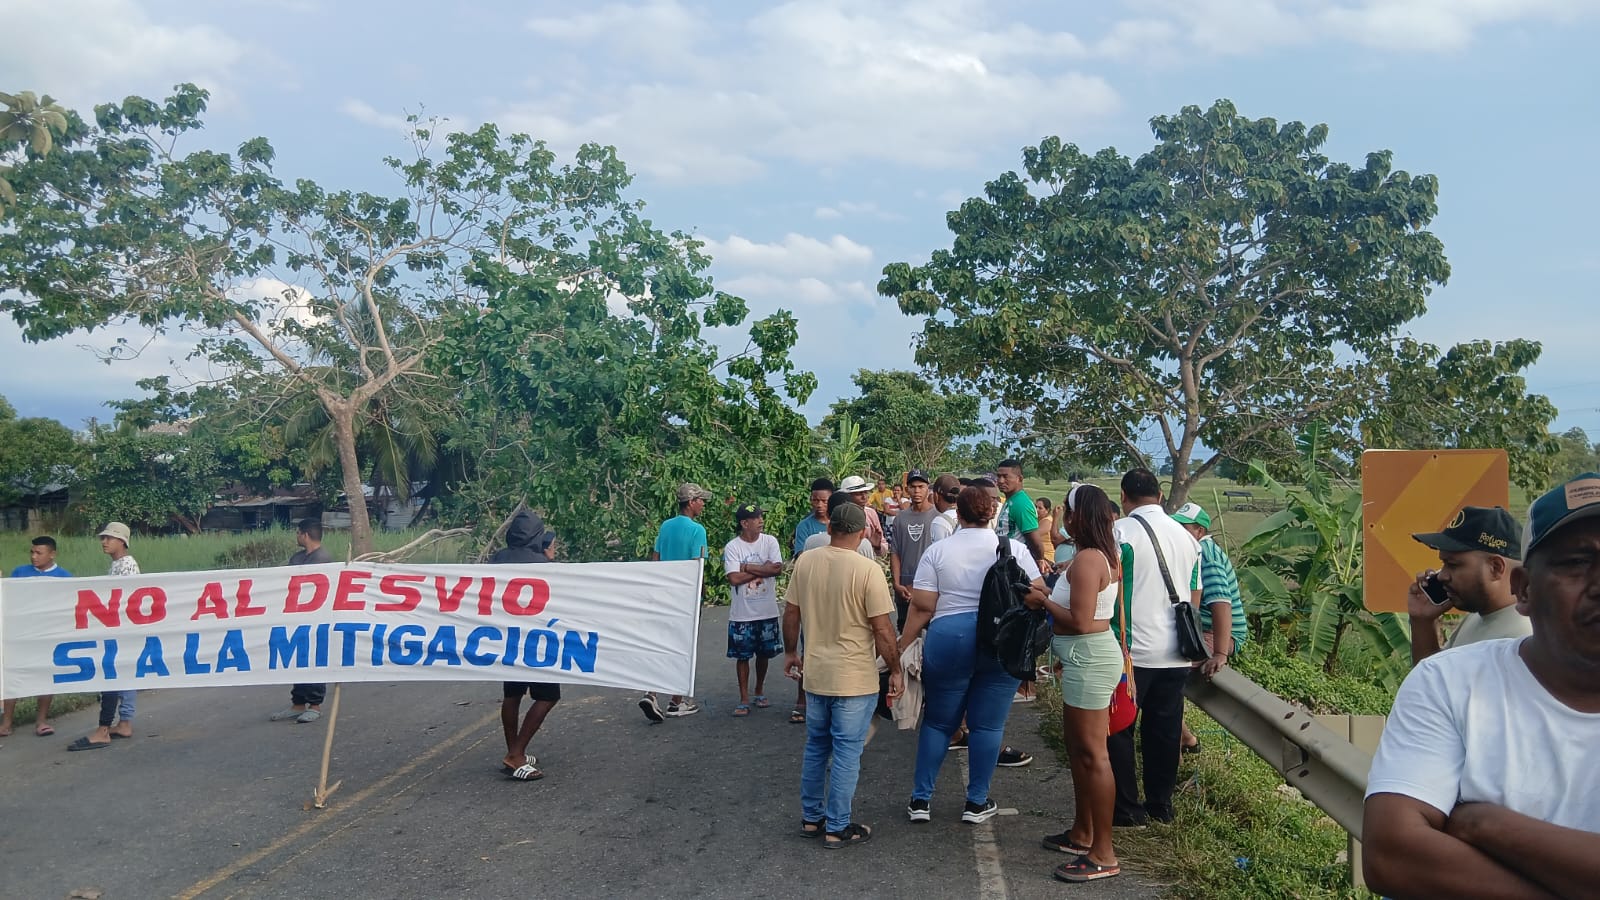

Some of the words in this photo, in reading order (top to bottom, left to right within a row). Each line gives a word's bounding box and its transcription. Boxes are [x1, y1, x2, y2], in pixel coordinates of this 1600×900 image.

[75, 587, 167, 629] NO
[191, 580, 266, 621] AL
[283, 570, 550, 616] DESVIO
[53, 640, 118, 684] SI
[136, 636, 170, 678] A
[183, 630, 251, 673] LA
[268, 618, 599, 673] MITIGACIÓN
